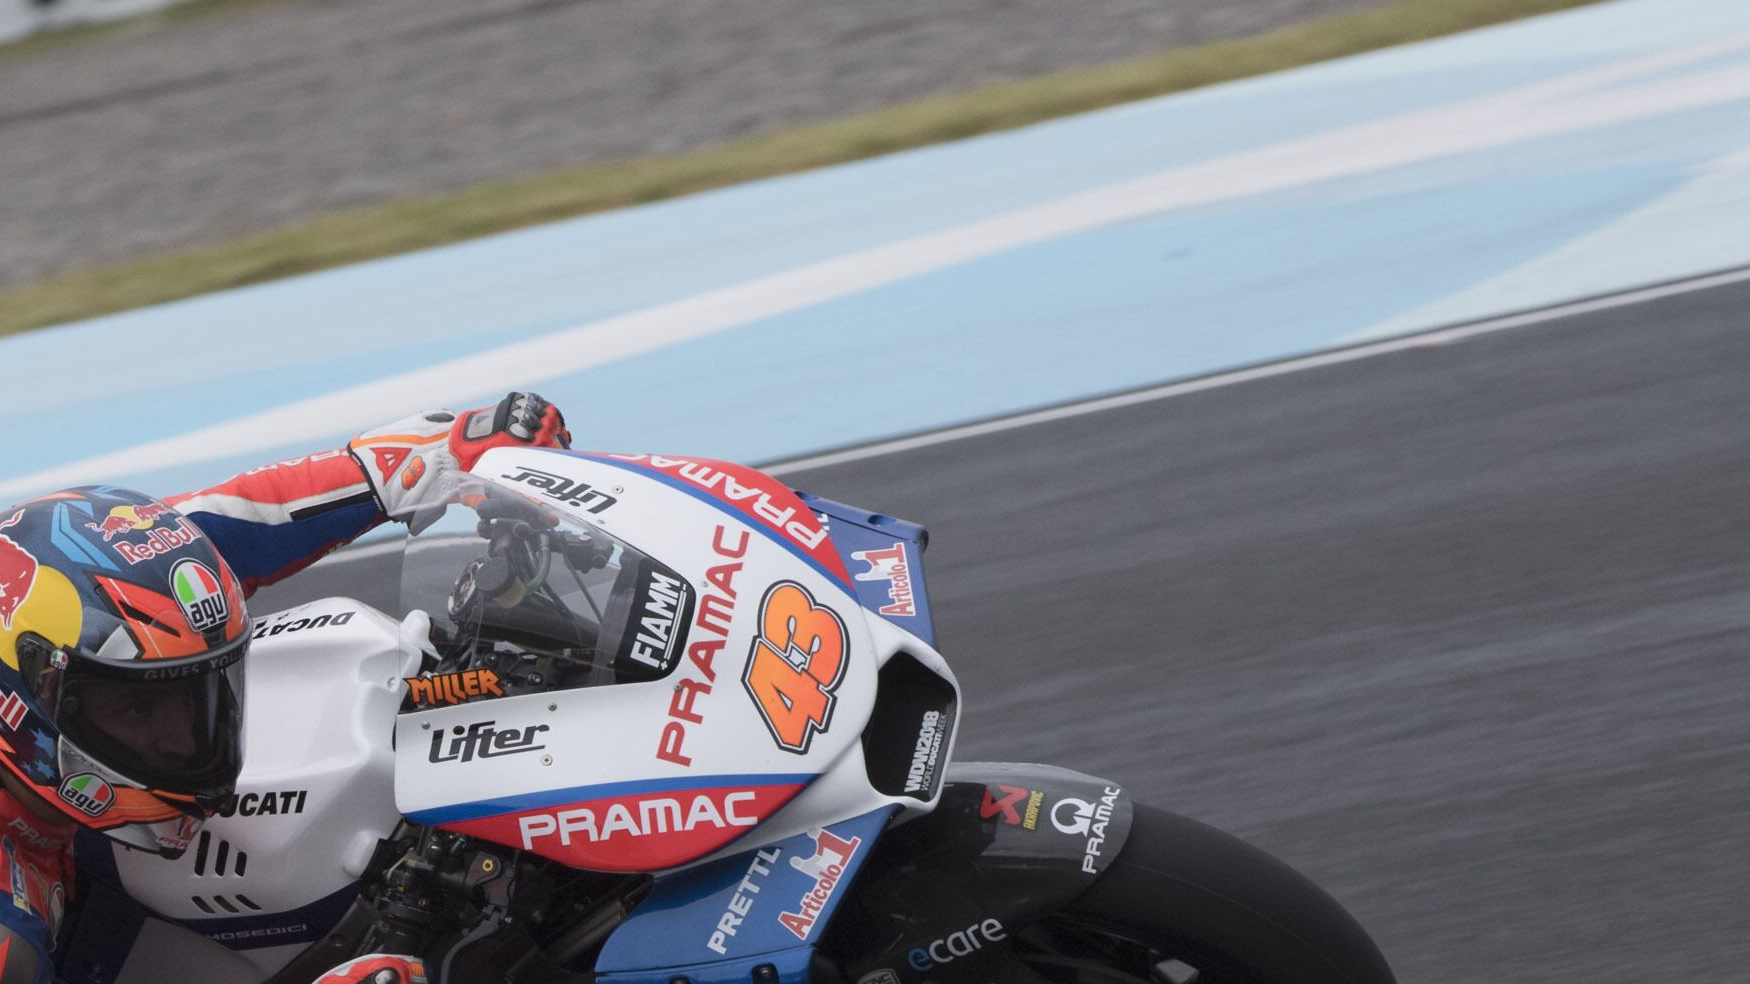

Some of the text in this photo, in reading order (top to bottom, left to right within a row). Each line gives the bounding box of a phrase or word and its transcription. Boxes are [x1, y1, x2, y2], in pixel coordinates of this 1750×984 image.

[501, 466, 617, 515] Lifter
[112, 530, 172, 565] Red
[252, 611, 356, 640] DUCAT
[630, 571, 683, 670] FIAMM
[655, 525, 750, 767] PRAMAC
[405, 667, 506, 706] MILLER
[741, 579, 851, 755] 43
[428, 720, 550, 764] Lifter
[215, 790, 308, 818] UCATI
[518, 790, 758, 850] PRAMAC
[1082, 786, 1121, 874] PRAMAC
[706, 846, 781, 955] PRETTL
[907, 917, 1007, 971] ecare
